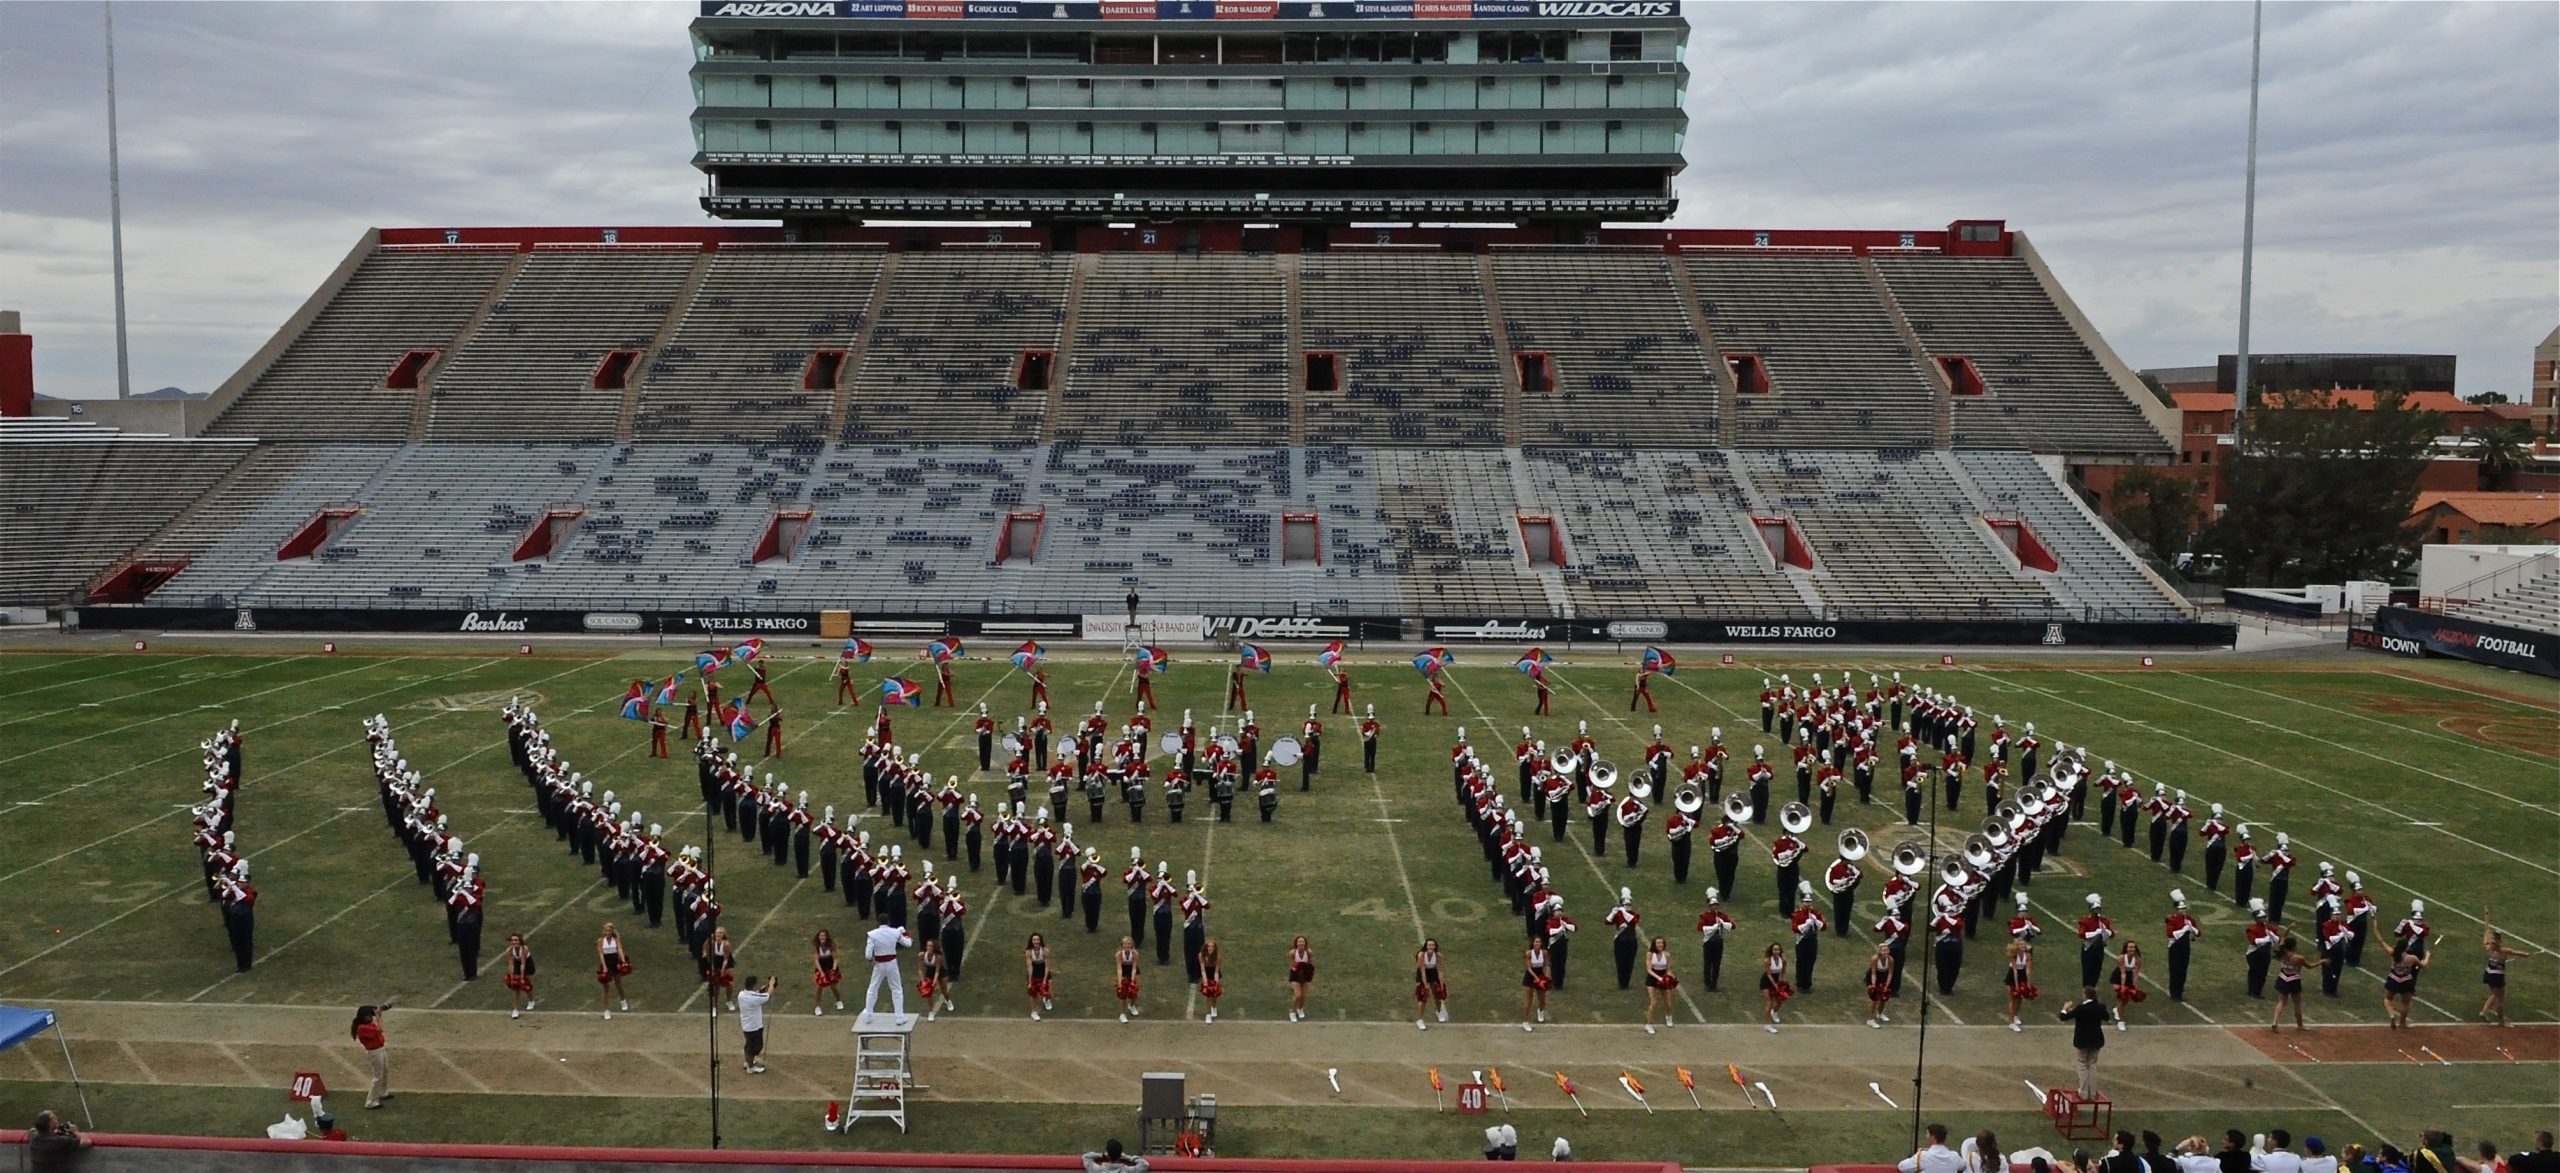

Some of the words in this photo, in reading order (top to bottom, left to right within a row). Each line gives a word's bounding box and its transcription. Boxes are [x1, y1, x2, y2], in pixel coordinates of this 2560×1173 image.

[715, 2, 836, 17] ARIZONA
[851, 4, 859, 12] 22
[860, 4, 873, 12] ART
[874, 4, 903, 12] LUPPINO
[916, 5, 936, 13] RICKY
[937, 5, 963, 13] HUNLEY
[974, 5, 998, 13] CHUCK
[998, 6, 1018, 14] CECIL
[1105, 6, 1134, 14] DARRYLL
[1136, 6, 1156, 14] LEWIS
[1479, 5, 1505, 13] ANTOINE
[1507, 5, 1529, 13] CASON
[1538, 2, 1672, 16] WILDCATS
[447, 235, 458, 244] 17
[604, 234, 616, 243] 18
[988, 234, 1001, 243] 20
[1144, 234, 1155, 243] 21
[1378, 235, 1389, 244] 22
[1585, 236, 1597, 244] 23
[1755, 237, 1768, 246] 24
[1900, 238, 1913, 247] 25
[72, 405, 82, 413] 16
[460, 612, 528, 631] Bashas'
[605, 616, 637, 625] CASINOS
[699, 618, 752, 629] WELLS
[756, 618, 808, 629] FARGO
[1086, 622, 1121, 632] UNIVERSITY
[1166, 622, 1185, 633] BAND
[1186, 622, 1200, 633] DAY
[1629, 626, 1662, 634] CASINOS
[1726, 626, 1780, 638] WELLS
[1784, 627, 1836, 638] FARGO
[2382, 636, 2419, 655] DOWN
[2432, 628, 2478, 647] ARIZONA
[2477, 636, 2536, 658] FOOTBALL
[1340, 897, 1488, 922] 40
[294, 1076, 313, 1097] 40
[1462, 1088, 1481, 1108] 40
